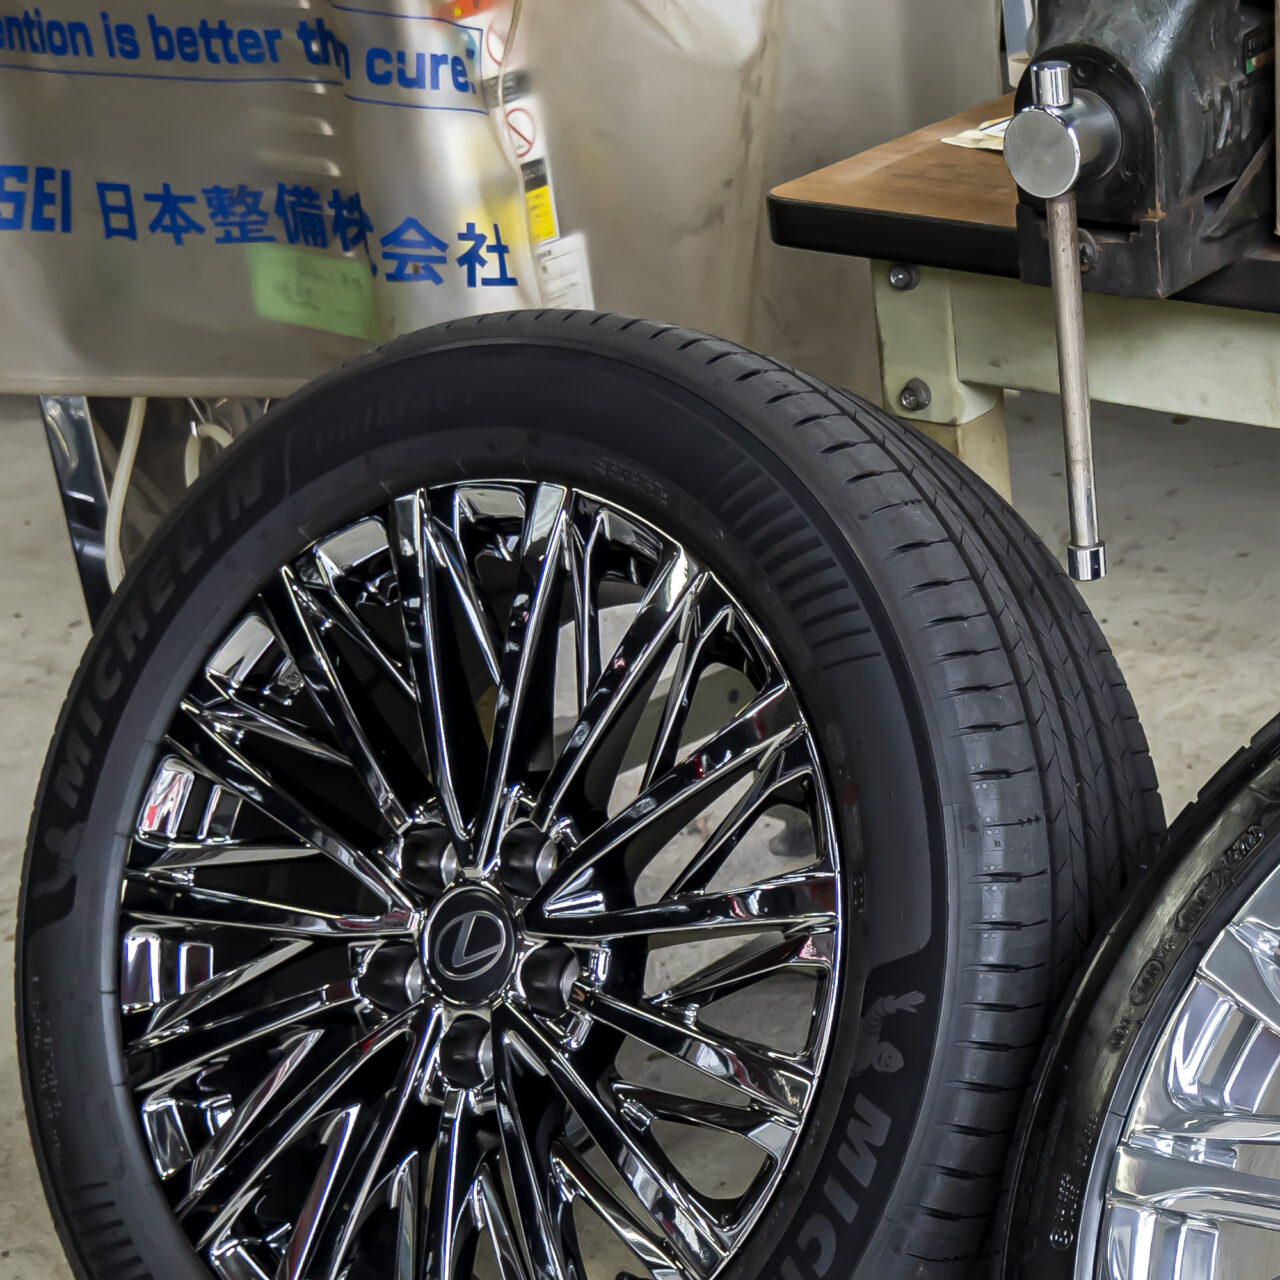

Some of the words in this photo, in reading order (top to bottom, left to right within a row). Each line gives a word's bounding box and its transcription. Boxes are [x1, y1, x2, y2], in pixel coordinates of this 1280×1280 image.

[0, 8, 94, 57] ntion
[100, 11, 140, 60] is
[147, 14, 282, 64] better
[96, 182, 519, 288] 日本整備株会社
[53, 455, 268, 808] MICHELIN
